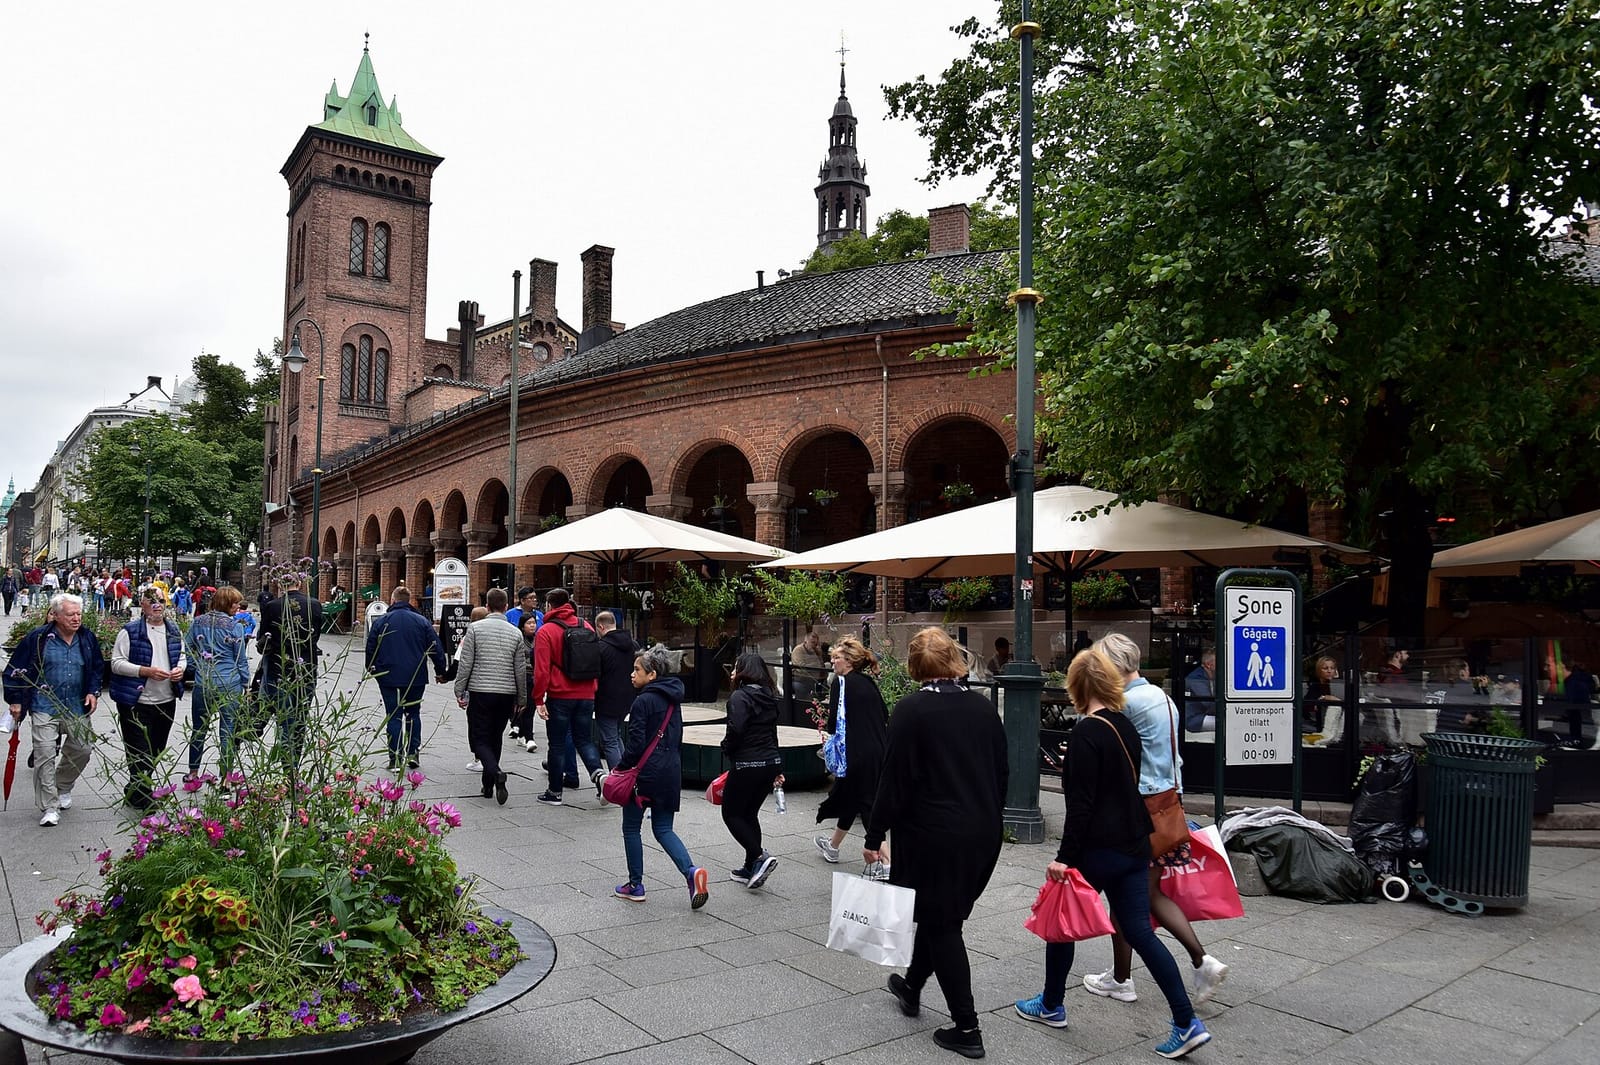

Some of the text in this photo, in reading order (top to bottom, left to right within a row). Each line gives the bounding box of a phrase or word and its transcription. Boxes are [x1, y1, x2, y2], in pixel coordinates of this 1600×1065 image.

[1238, 595, 1282, 615] Sone
[1242, 628, 1277, 642] Gågate
[1235, 706, 1284, 716] Varetransport
[1249, 718, 1270, 727] tillatt
[1244, 733, 1273, 742] 00-11
[1242, 749, 1277, 760] (00-09)
